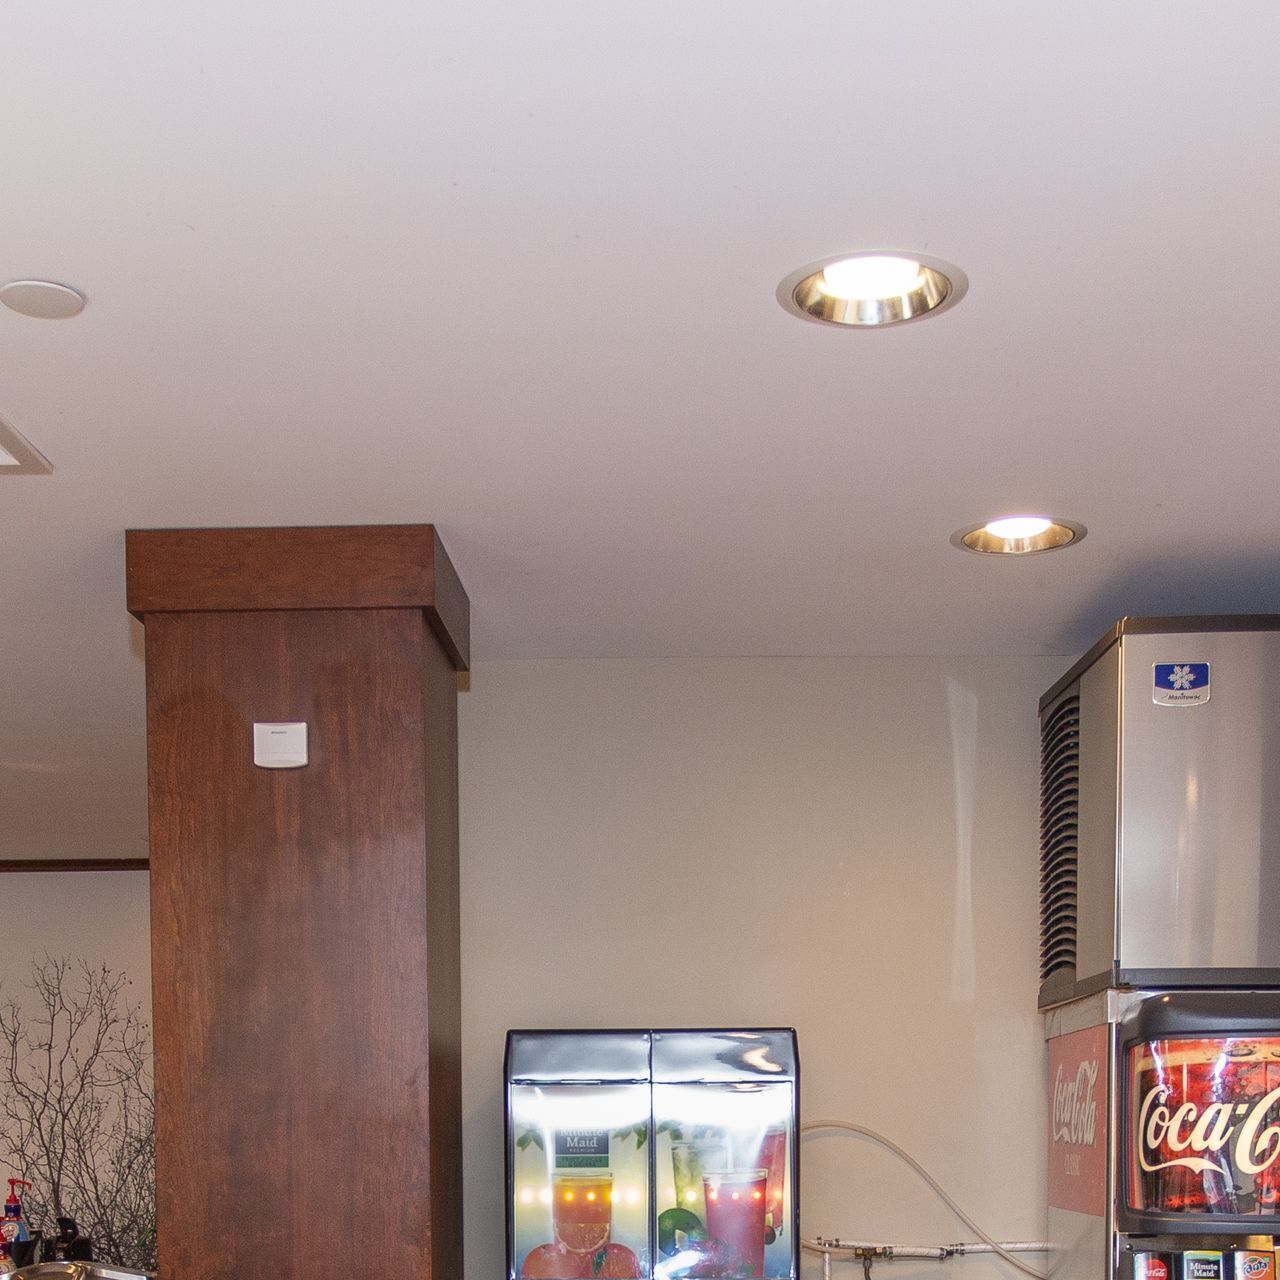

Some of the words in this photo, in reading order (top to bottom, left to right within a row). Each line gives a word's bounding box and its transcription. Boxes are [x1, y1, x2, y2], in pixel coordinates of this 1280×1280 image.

[1053, 1060, 1099, 1146] Coca-Cola
[566, 1136, 599, 1148] Maid
[1189, 1262, 1218, 1271] Minute
[1193, 1269, 1215, 1278] Maid
